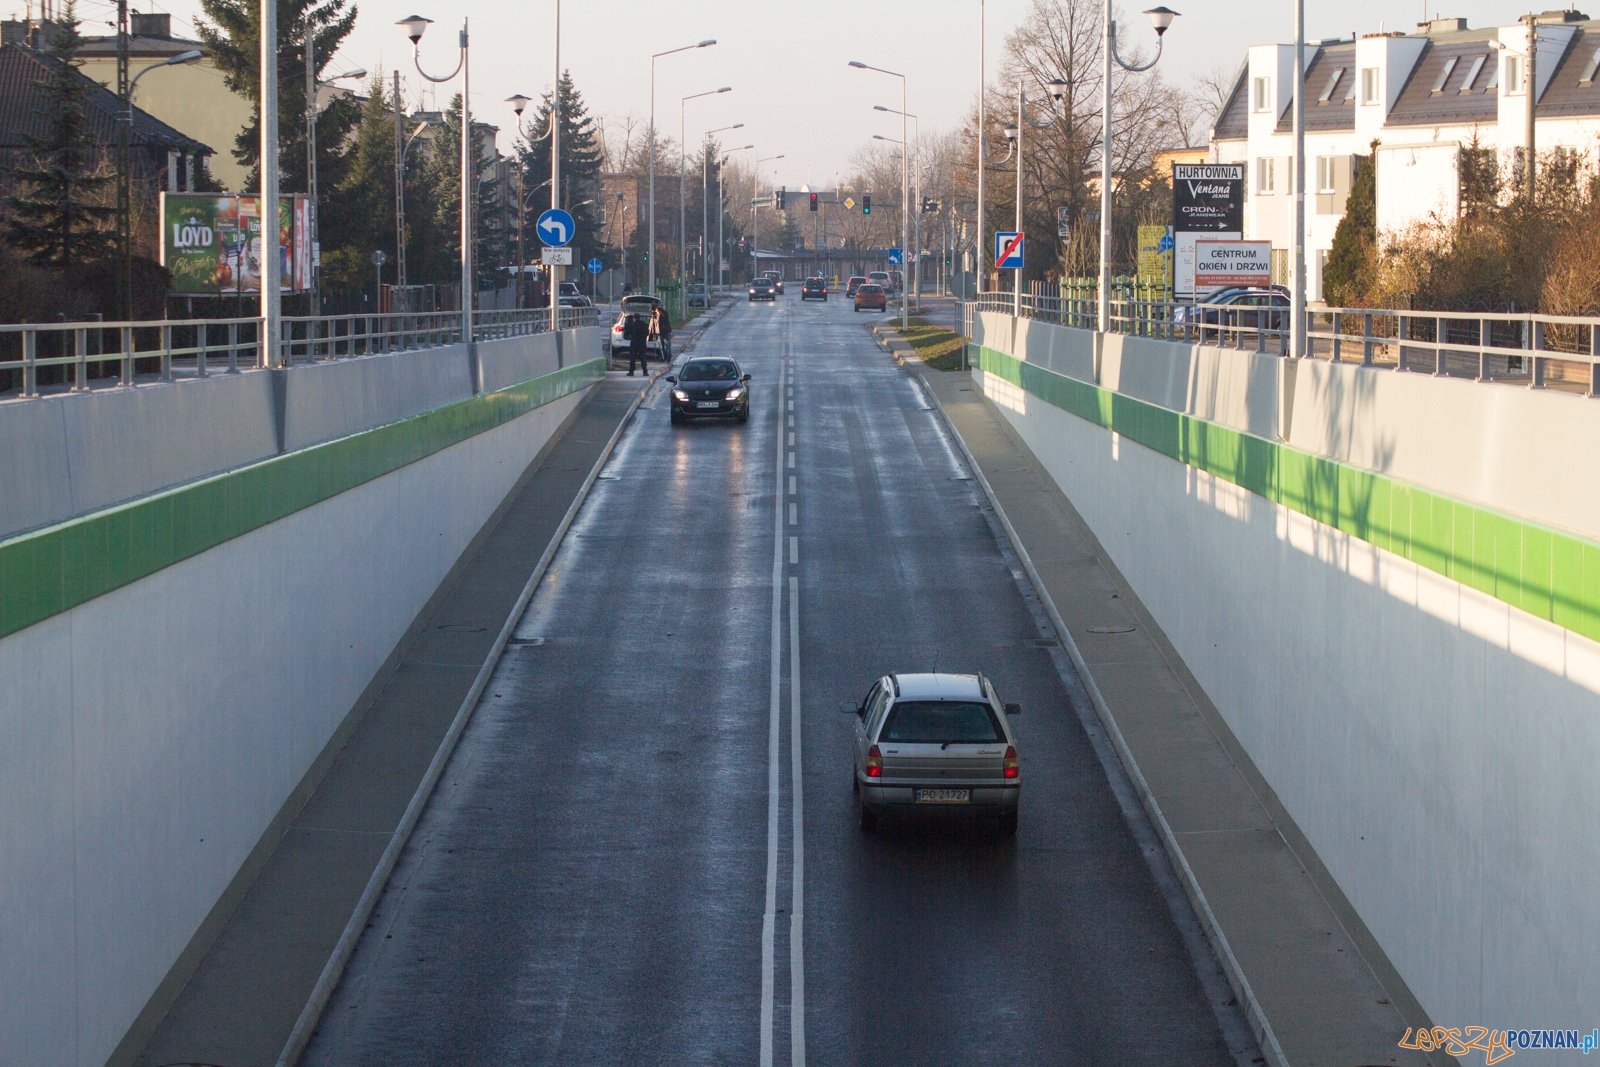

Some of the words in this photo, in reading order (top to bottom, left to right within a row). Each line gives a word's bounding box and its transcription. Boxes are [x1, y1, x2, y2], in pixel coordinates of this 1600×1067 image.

[1179, 167, 1238, 178] HURTOWNIA
[1187, 180, 1231, 199] Ventana
[173, 223, 213, 248] LOYD
[1211, 250, 1257, 258] CENTRUM
[1199, 262, 1227, 271] OKIEN
[1236, 262, 1268, 271] DRZWI
[922, 790, 936, 799] PO
[939, 790, 968, 799] 21727
